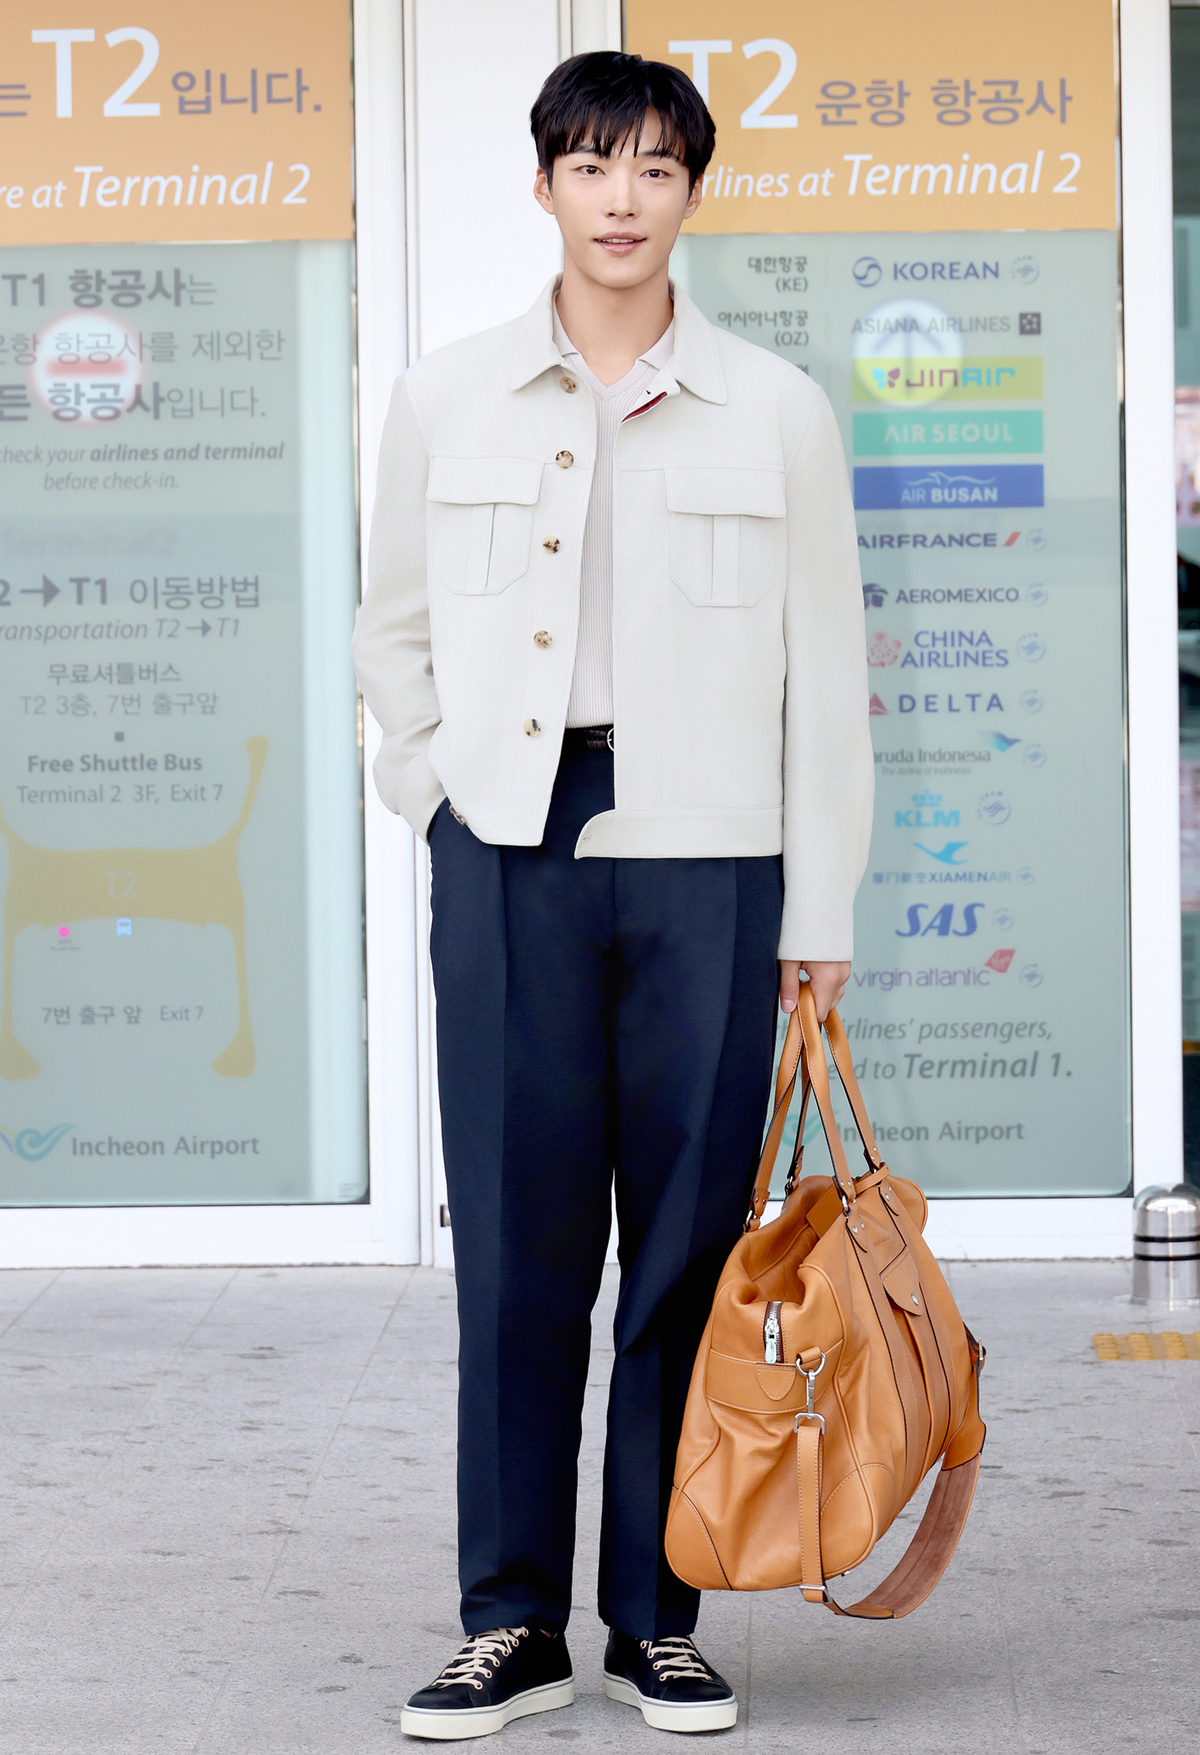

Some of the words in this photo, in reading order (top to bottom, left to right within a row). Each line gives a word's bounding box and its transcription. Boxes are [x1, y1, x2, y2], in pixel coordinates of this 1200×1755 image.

[668, 38, 798, 129] T2
[815, 79, 911, 126] 운항
[931, 78, 1073, 125] 항공사
[32, 180, 67, 208] at
[73, 160, 274, 208] Terminal
[281, 163, 311, 204] 2
[797, 169, 834, 196] at
[842, 150, 1045, 196] Terminal
[1053, 152, 1082, 193] 2
[748, 256, 809, 275] 대한항공
[893, 261, 1000, 282] KOREAN
[1, 273, 46, 306] T1
[775, 276, 810, 293] (KE)
[717, 309, 810, 328] 아시아나항공
[852, 317, 922, 335] ASIANA
[926, 316, 1012, 334] AIRLINES
[191, 329, 285, 362] 제외한
[774, 330, 810, 347] (OZ)
[882, 424, 927, 444] AIR
[932, 422, 1015, 443] SEOUL
[0, 444, 43, 464] heck
[46, 448, 86, 468] your
[90, 443, 158, 463] airlines
[164, 443, 200, 462] and
[205, 441, 285, 461] terminal
[43, 473, 98, 491] before
[103, 470, 180, 490] check-in.
[900, 488, 927, 503] AIR
[930, 486, 998, 502] BUSAN
[69, 576, 108, 606] T1
[130, 574, 260, 610] 이동방법
[895, 587, 1020, 604] AEROMEXICO
[155, 618, 181, 639] T2
[217, 616, 241, 638] T1
[914, 629, 994, 649] CHINA
[900, 649, 1010, 669] AIRLINES
[47, 661, 182, 686] 무료셔틀버스
[20, 694, 47, 716] T2
[107, 691, 142, 716] 7번
[898, 693, 1005, 713] DELTA
[27, 755, 74, 773] Free
[80, 752, 158, 773] Shuttle
[164, 754, 203, 771] Bus
[918, 747, 992, 763] Indonesia
[16, 783, 104, 804] Terminal
[110, 785, 122, 803] 2
[133, 785, 160, 805] 3F,
[170, 783, 207, 803] Exit
[213, 784, 224, 802] 7
[894, 809, 961, 829] KLM
[102, 870, 140, 899] T2
[895, 902, 986, 938] SAS
[853, 969, 913, 992] virgin
[915, 968, 991, 987] atlantic
[42, 1006, 72, 1026] 7번
[159, 1005, 191, 1022] Exit
[195, 1005, 205, 1021] 7
[917, 1018, 1053, 1044] passengers,
[873, 1060, 896, 1080] to
[904, 1050, 1039, 1080] Terminal
[1049, 1052, 1073, 1078] 1.
[837, 1121, 930, 1142] Inheon
[938, 1120, 1025, 1145] Airport
[71, 1136, 166, 1157] Incheon
[173, 1135, 260, 1160] Airport
